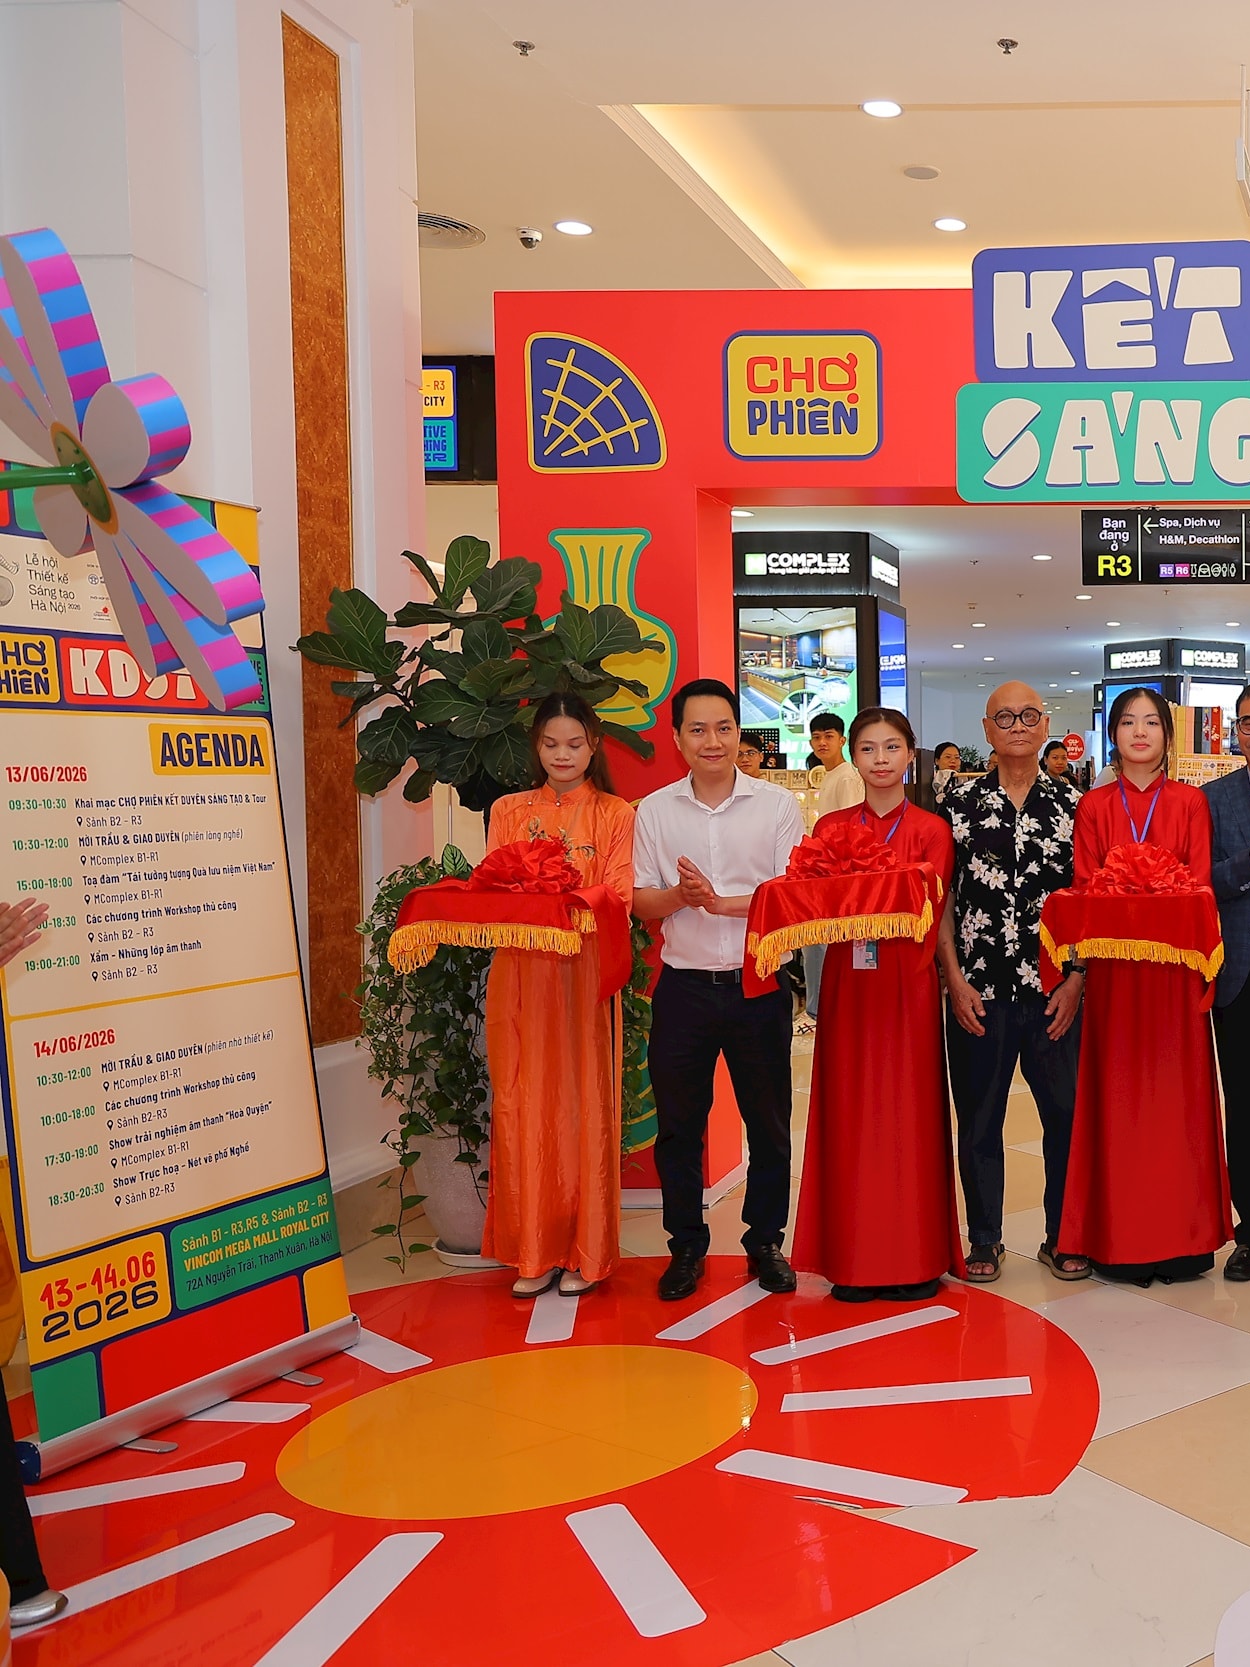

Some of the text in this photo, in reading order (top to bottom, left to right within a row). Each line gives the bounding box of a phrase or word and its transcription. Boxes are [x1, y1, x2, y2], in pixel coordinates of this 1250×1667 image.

[993, 256, 1241, 369] KẾT
[434, 380, 445, 391] R3
[747, 352, 859, 404] CHỢ
[424, 396, 445, 407] CITY
[1102, 518, 1126, 530] Bạn
[1159, 517, 1220, 529] Spa, Dịch vụ
[1099, 530, 1130, 542] đang
[1110, 541, 1119, 552] ở
[1159, 535, 1240, 545] H&M, Decathlon
[25, 552, 59, 570] Lễ hội
[767, 552, 850, 567] COMPLEX
[1098, 555, 1132, 577] R3
[26, 568, 69, 585] Thiết kế
[1160, 566, 1189, 575] R5 R6
[28, 584, 75, 602] Sáng tạo
[30, 599, 47, 612] Hà
[49, 601, 67, 615] Nội
[0, 640, 49, 674] HỢ
[1121, 650, 1161, 662] COMPLEX
[1194, 650, 1238, 662] COMPLEX
[160, 732, 265, 768] AGENDA
[6, 765, 87, 783] 13/06/2026
[9, 799, 67, 811] 09:30-10:30
[75, 798, 93, 809] Khai
[96, 800, 116, 811] mạc
[118, 796, 137, 810] CHỢ
[139, 794, 163, 806] PHIÊN
[181, 793, 206, 805] DUYÊN
[208, 793, 228, 804] SÁNG
[230, 794, 243, 806] TẠO
[245, 794, 250, 803] &
[252, 794, 266, 803] Tour
[86, 815, 142, 828] Sảnh B2 R3
[12, 838, 69, 851] 10:30-12:00
[79, 835, 93, 848] MỜI
[122, 835, 130, 845] &
[133, 833, 153, 844] GIAO
[155, 830, 180, 843] DUYÊN
[90, 851, 159, 867] MComplex B1-R1
[17, 877, 73, 891] 15:00-18:00
[82, 875, 98, 888] Toạ
[100, 874, 120, 885] đàm
[242, 862, 257, 875] Việt
[94, 888, 163, 905] MComplex B1-R1
[86, 913, 102, 925] Các
[104, 911, 139, 923] chương
[141, 907, 163, 919] trình
[164, 904, 201, 916] Workshop
[217, 901, 237, 911] công
[97, 927, 154, 943] Sảnh B2 R3
[25, 955, 80, 971] 19:00-21:00
[166, 944, 179, 953] âm
[180, 940, 202, 952] thanh
[101, 964, 158, 981] Sảnh B2 R3
[33, 1028, 116, 1058] 14/06/2026
[37, 1066, 92, 1087] 10:30-12:00
[101, 1061, 117, 1074] MỜI
[145, 1054, 153, 1065] &
[156, 1050, 176, 1063] GIAO
[178, 1043, 203, 1059] DUYÊN
[113, 1067, 182, 1091] MComplex B1-R1
[40, 1071, 256, 1127] 10:00-18:00 Các chương trình Workshop công
[117, 1108, 168, 1129] Sảnh B2-R3
[45, 1144, 99, 1167] 17:30-19:00
[109, 1137, 133, 1151] Show
[154, 1124, 187, 1141] nghiệm
[189, 1121, 201, 1131] âm
[203, 1113, 224, 1127] thanh
[121, 1141, 190, 1167] MComplex B1-R1
[48, 1182, 105, 1207] 18:30-20:30
[113, 1175, 137, 1189] Show
[124, 1182, 176, 1205] Sảnh B2-R3
[182, 1192, 328, 1253] Sảnh B1 R3,R5 & Sảnh B2 R3
[183, 1211, 330, 1272] VINCOM MEGA MALL ROYAL CITY
[186, 1278, 204, 1292] 72A
[258, 1249, 284, 1265] Thanh
[309, 1236, 320, 1248] Hà
[40, 1250, 156, 1312] 13-14.06
[41, 1280, 160, 1343] 2026
